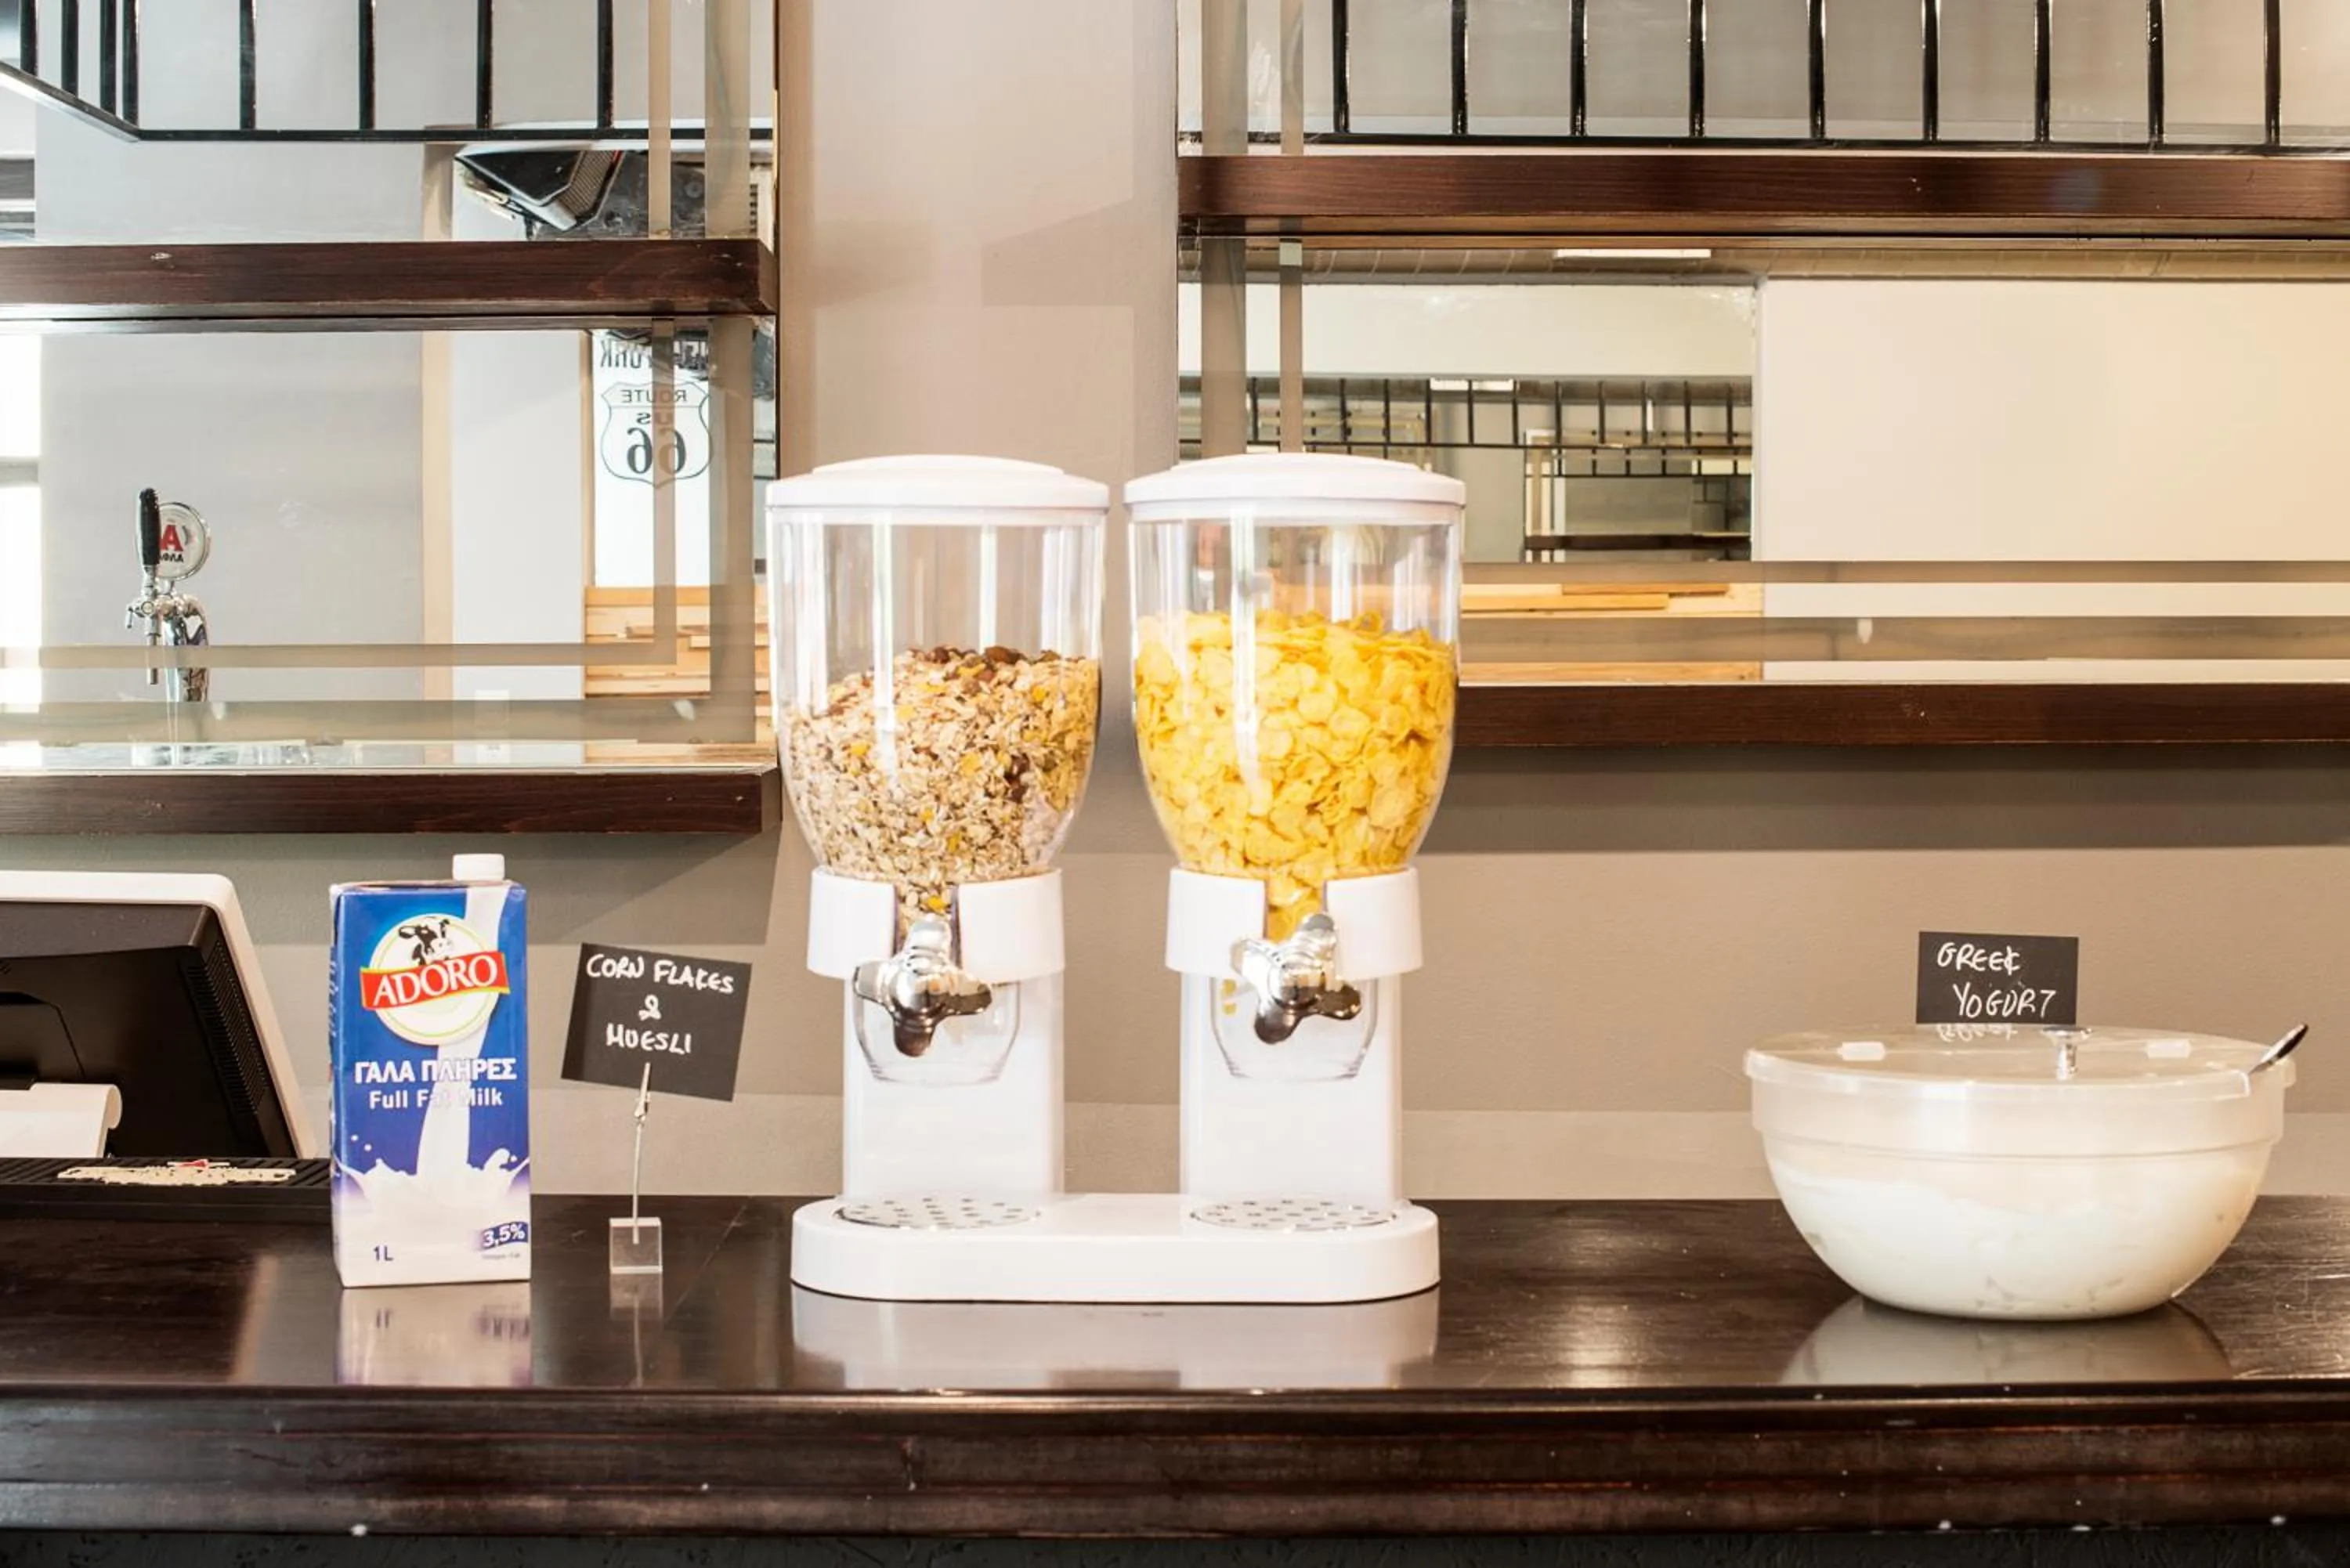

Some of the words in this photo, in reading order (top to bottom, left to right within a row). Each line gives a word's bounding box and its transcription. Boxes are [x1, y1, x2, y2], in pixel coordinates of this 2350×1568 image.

[587, 953, 645, 979] CORN
[653, 959, 735, 994] FLAKES
[1937, 942, 2020, 976] GREEK
[373, 955, 498, 1006] ADORO
[1953, 981, 2056, 1018] YOGURT
[606, 1022, 692, 1055] MUESLI
[355, 1060, 416, 1084] ΓΑΛΑ
[421, 1058, 517, 1082] ΠΛΗΡΕΣ
[369, 1090, 408, 1109] Full
